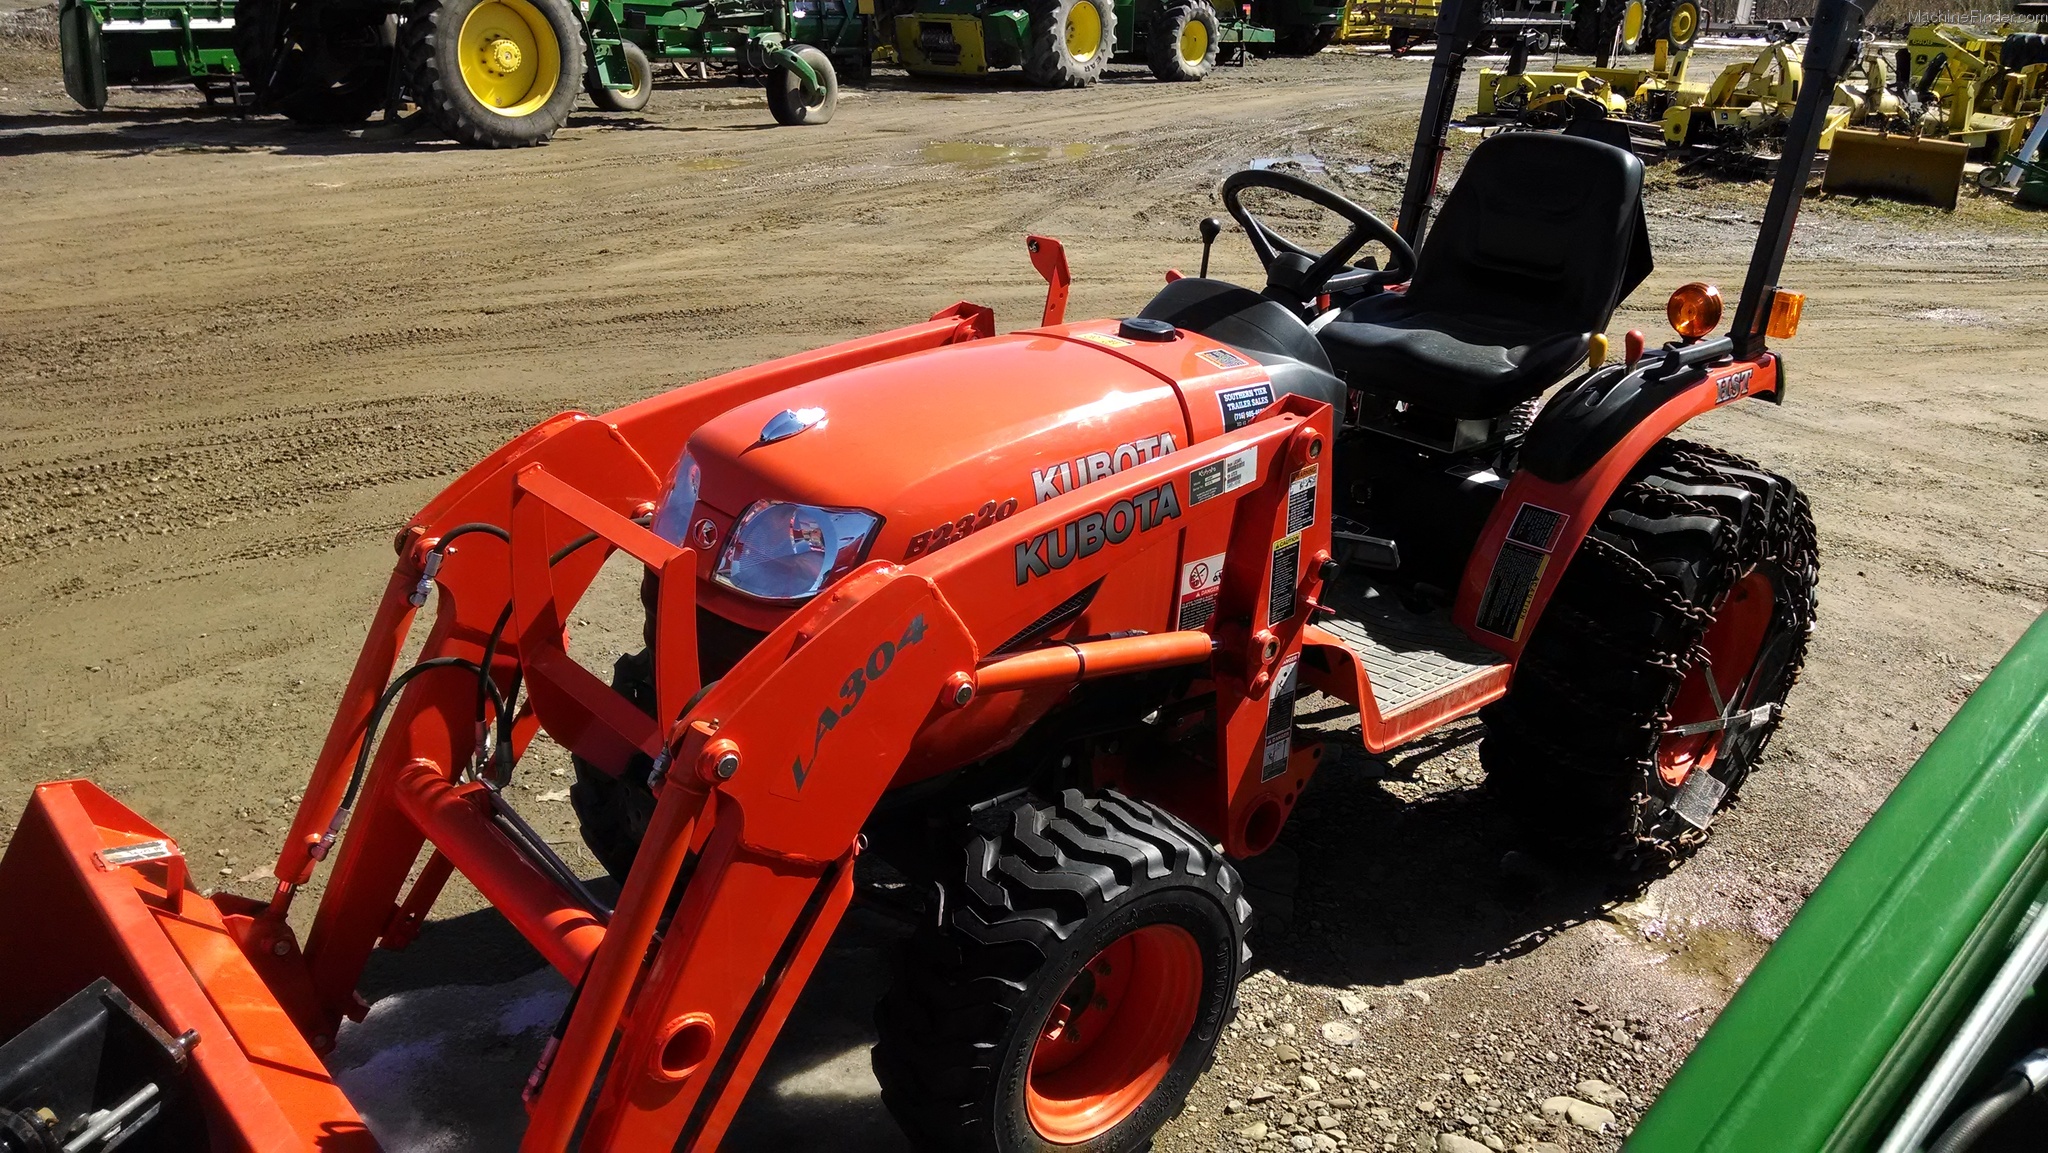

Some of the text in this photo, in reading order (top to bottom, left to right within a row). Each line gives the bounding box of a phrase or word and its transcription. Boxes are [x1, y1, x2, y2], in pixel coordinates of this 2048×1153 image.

[1223, 386, 1268, 402] SOUTHERN TIER
[1227, 396, 1269, 411] TRAILER SALES
[1715, 368, 1753, 405] HST
[1030, 431, 1179, 505] KUBOTA
[902, 497, 1018, 561] B2320
[1015, 481, 1181, 586] KUBOTA
[1280, 535, 1300, 547] CAUTION
[1201, 586, 1220, 596] DANGER
[1520, 581, 1538, 620] CAUTION
[792, 613, 928, 793] LA304
